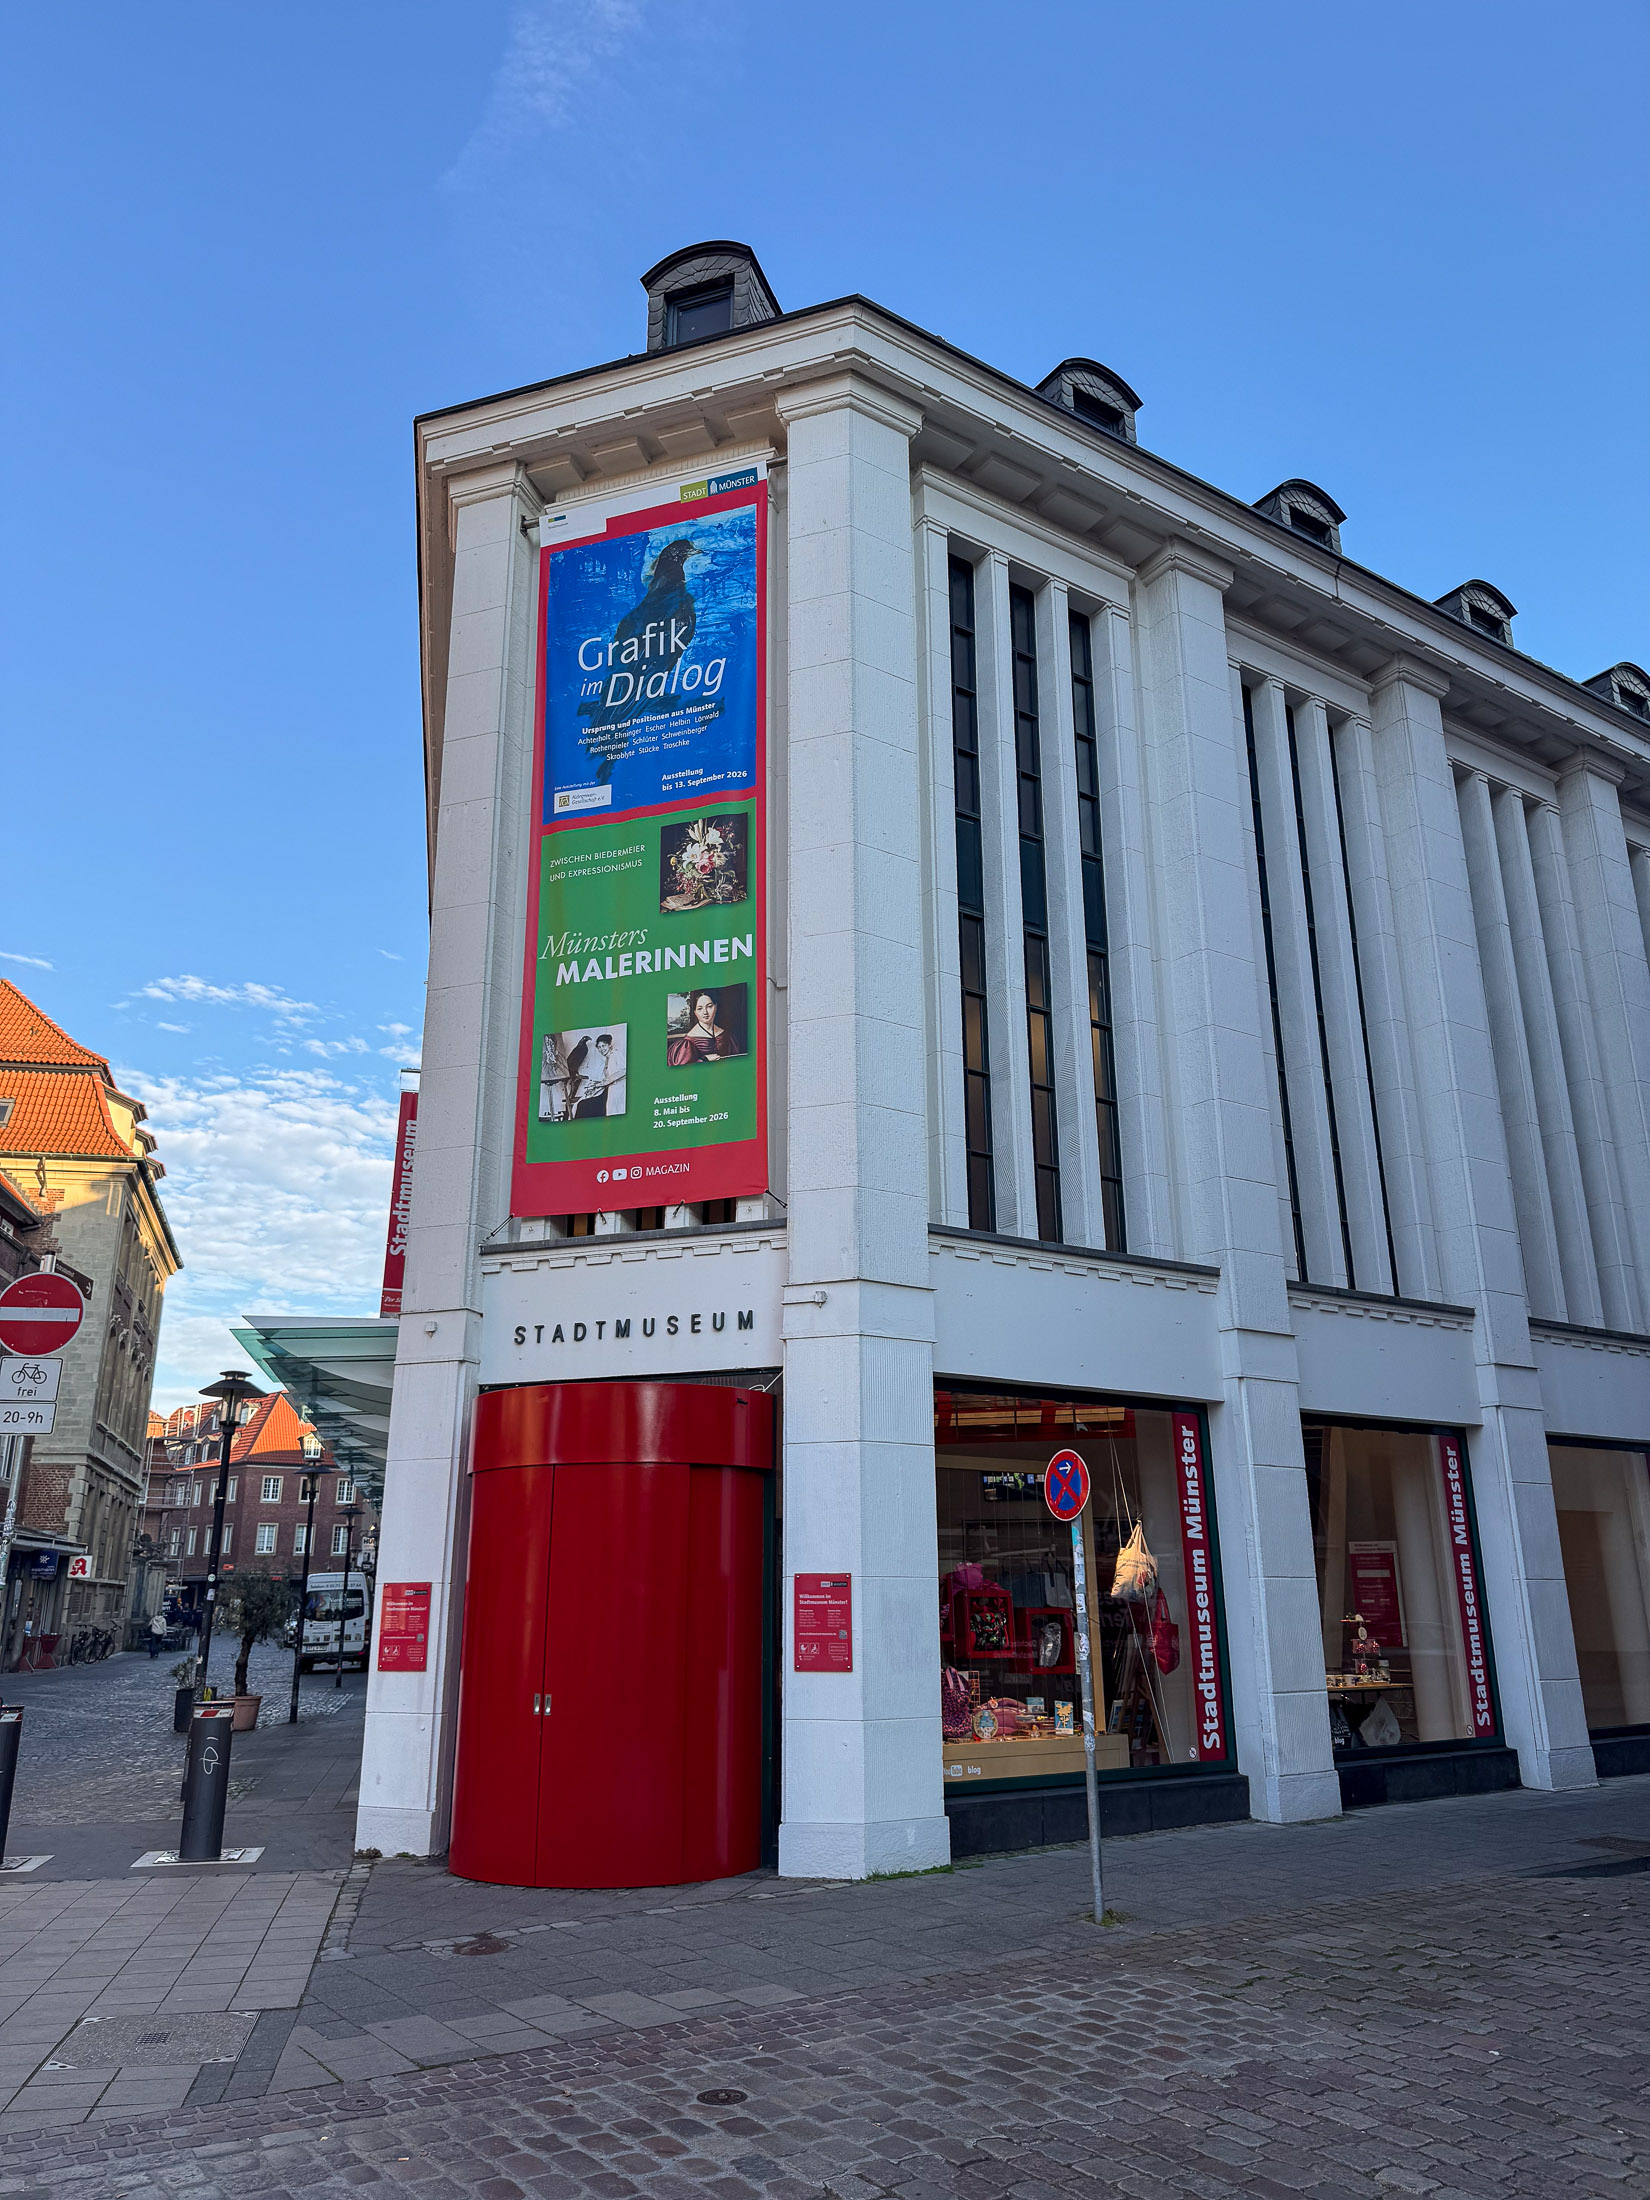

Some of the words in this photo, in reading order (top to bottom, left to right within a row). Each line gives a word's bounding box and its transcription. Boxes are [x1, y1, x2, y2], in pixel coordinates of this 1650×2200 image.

[683, 487, 707, 500] STADT
[718, 475, 755, 492] MÜNSTER
[578, 618, 688, 671] Grafik
[580, 678, 603, 697] im
[605, 657, 727, 708] Dialog
[577, 733, 611, 745] Achterholt
[614, 728, 642, 740] Ehninger
[645, 723, 666, 733] Escher
[669, 718, 691, 728] Helbin
[582, 723, 616, 735] Ursprung
[617, 719, 631, 729] und
[632, 713, 670, 725] Positionen
[671, 709, 684, 718] aus
[685, 702, 716, 714] Münster
[590, 741, 630, 754] Rothenpieler
[632, 735, 658, 746] Schlüter
[661, 725, 708, 740] Schweinberger
[638, 745, 660, 755] Stücke
[663, 739, 690, 750] Troschke
[661, 768, 704, 781] Ausstellung
[675, 781, 686, 789] 13.
[687, 773, 725, 787] September
[726, 770, 748, 779] 2026
[550, 854, 592, 868] ZWISCHEN
[594, 844, 646, 860] BIEDERMEIER
[549, 871, 566, 882] UND
[568, 859, 643, 878] EXPRESSIONISMUS
[539, 928, 648, 960] Münsters
[555, 934, 753, 986] MALERINNEN
[653, 1093, 698, 1105] Ausstellung
[653, 1109, 662, 1117] 8.
[663, 1106, 678, 1116] Mai
[679, 1105, 691, 1113] bis
[653, 1121, 666, 1129] 20.
[667, 1116, 708, 1128] September
[708, 1112, 729, 1122] 2026
[645, 1162, 690, 1177] MAGAZIN
[389, 1119, 418, 1257] Stadtmuseum
[514, 1310, 754, 1345] STADTMUSEUM
[17, 1387, 38, 1398] frei
[3, 1411, 44, 1424] 20-9h
[1181, 1425, 1204, 1540] Münster
[1445, 1446, 1469, 1546] Münster
[1194, 1549, 1221, 1750] Stadtmuseum
[1458, 1552, 1491, 1727] Stadtmuseum
[968, 1765, 981, 1775] blog
